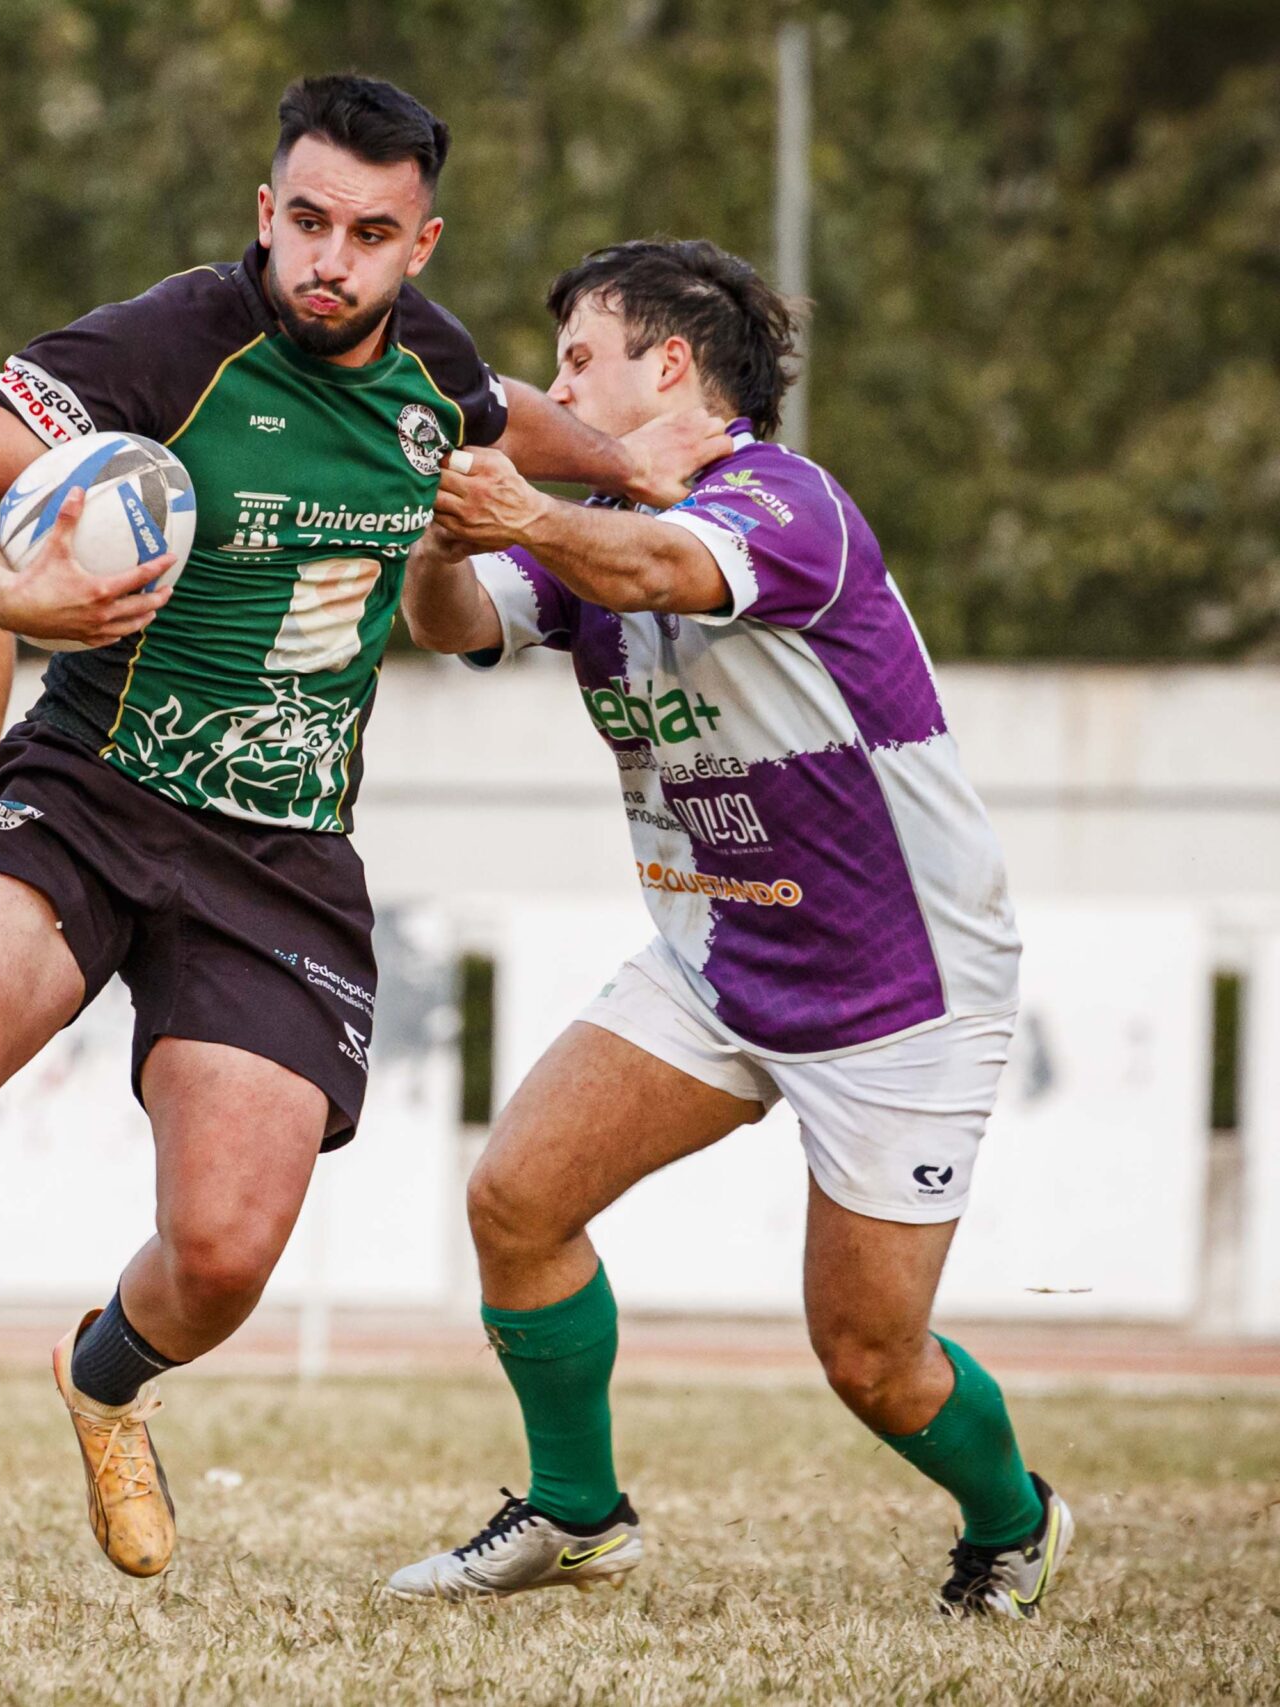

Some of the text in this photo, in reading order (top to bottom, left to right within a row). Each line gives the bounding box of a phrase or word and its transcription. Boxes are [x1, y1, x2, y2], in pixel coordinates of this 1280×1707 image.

[249, 414, 286, 429] AMURA
[694, 752, 745, 776] ética
[306, 973, 336, 994] Centro
